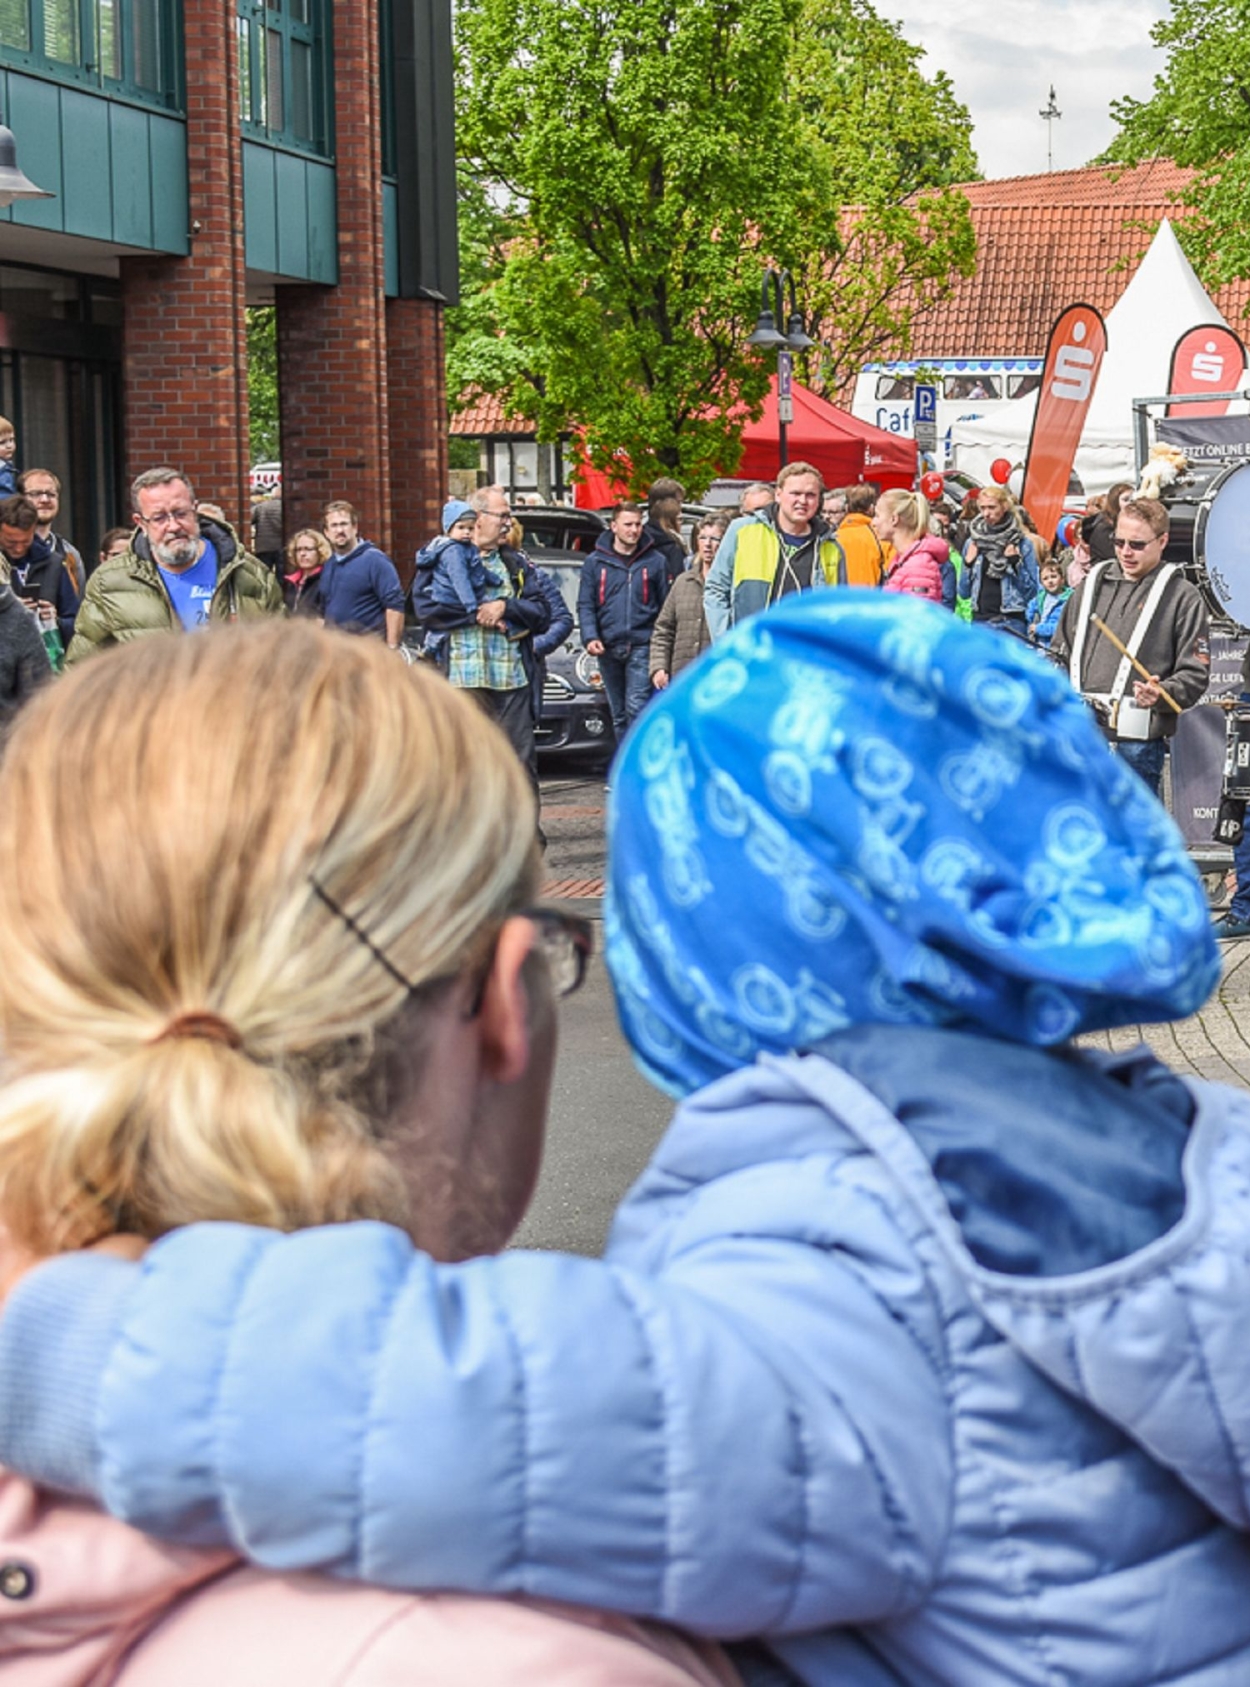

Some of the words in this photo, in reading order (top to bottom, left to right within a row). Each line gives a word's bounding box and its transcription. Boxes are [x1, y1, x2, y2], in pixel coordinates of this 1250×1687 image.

[919, 389, 932, 419] P
[876, 407, 916, 433] Caf
[1182, 445, 1205, 458] ETZT
[1206, 443, 1243, 456] ONLINE
